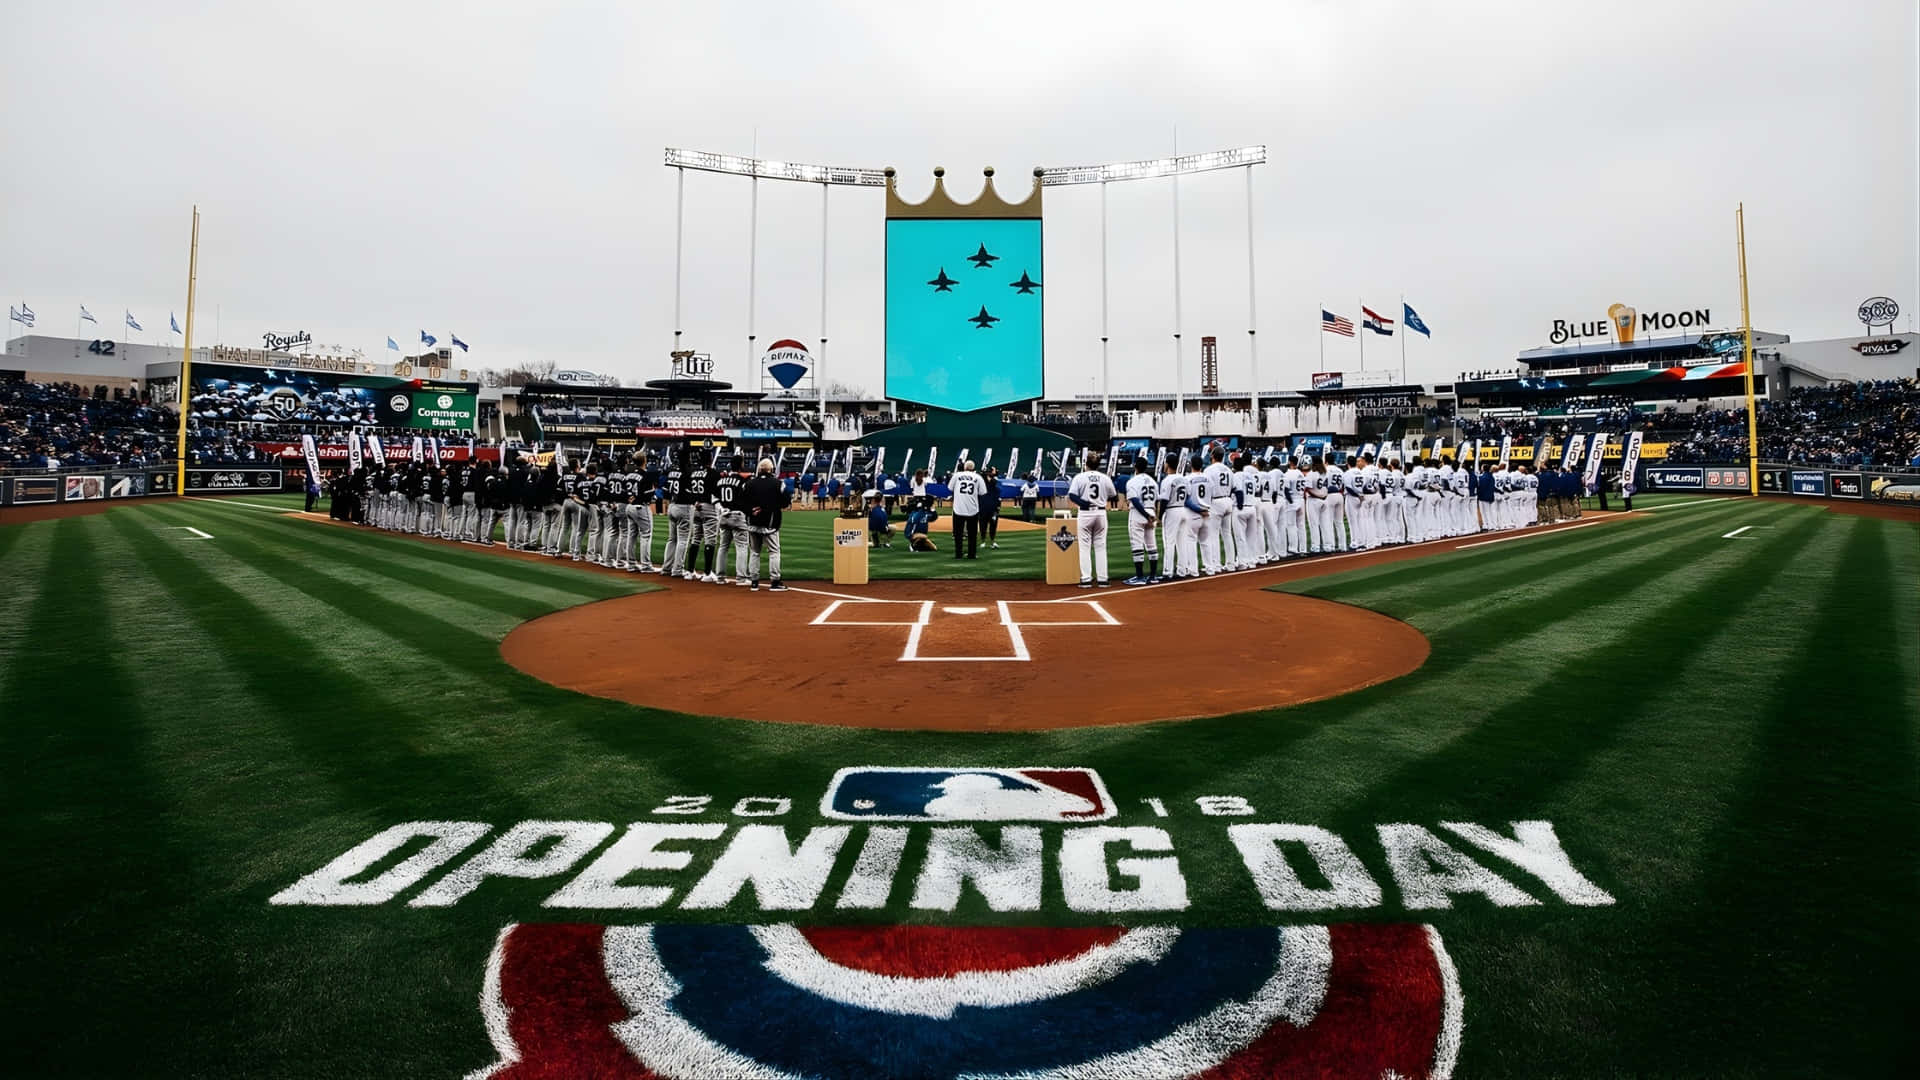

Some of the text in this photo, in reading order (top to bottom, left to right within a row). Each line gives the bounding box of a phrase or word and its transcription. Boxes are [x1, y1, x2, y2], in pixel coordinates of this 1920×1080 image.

[1550, 309, 1710, 344] BLUE MOON
[88, 339, 116, 357] 42
[263, 331, 312, 351] Royals
[394, 362, 412, 377] 20
[679, 355, 714, 378] Lite
[273, 397, 296, 412] 50
[417, 407, 470, 418] Commerce
[431, 417, 457, 426] Bank
[1586, 439, 1604, 480] 2017
[1623, 438, 1640, 481] 2018
[1219, 472, 1230, 486] 21
[564, 481, 575, 493] 15
[608, 480, 622, 495] 30
[667, 480, 680, 495] 79
[691, 480, 705, 494] 26
[721, 487, 733, 502] 10
[959, 481, 975, 496] 23
[1089, 483, 1100, 500] 3
[1141, 485, 1155, 501] 25
[1198, 483, 1206, 499] 8
[653, 796, 1256, 817] 20 18
[268, 819, 1617, 913] OPENING DAY
